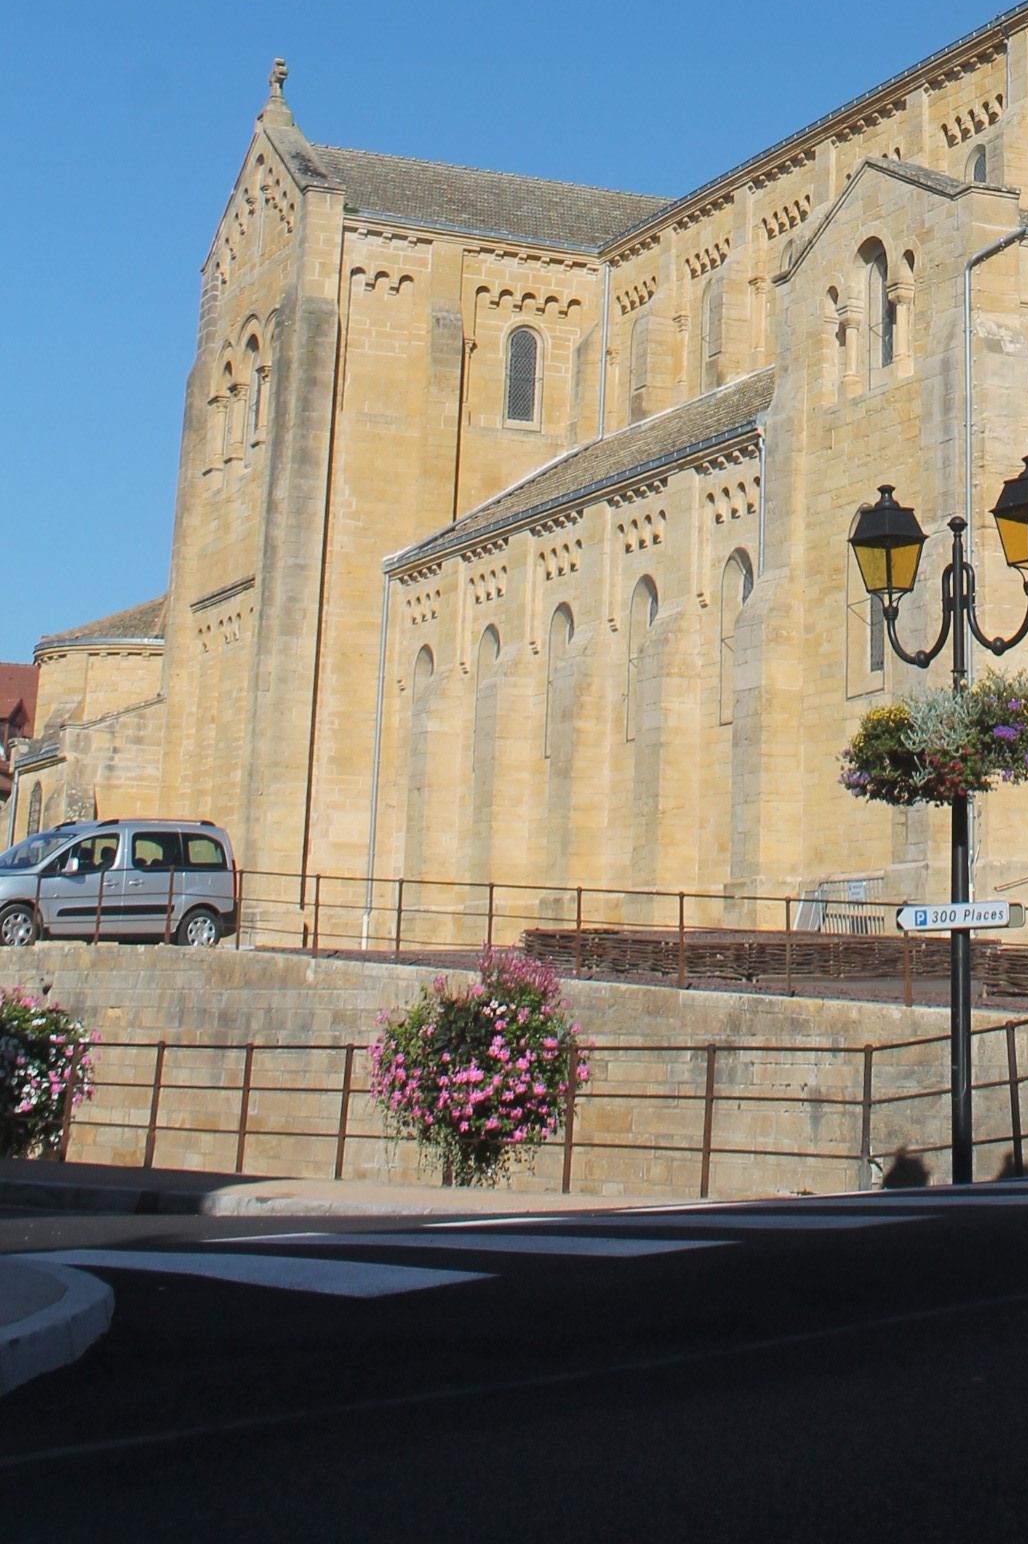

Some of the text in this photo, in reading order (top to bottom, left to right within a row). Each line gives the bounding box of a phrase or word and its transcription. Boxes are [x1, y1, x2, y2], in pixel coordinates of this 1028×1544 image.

[916, 908, 1004, 924] P 300 Places
